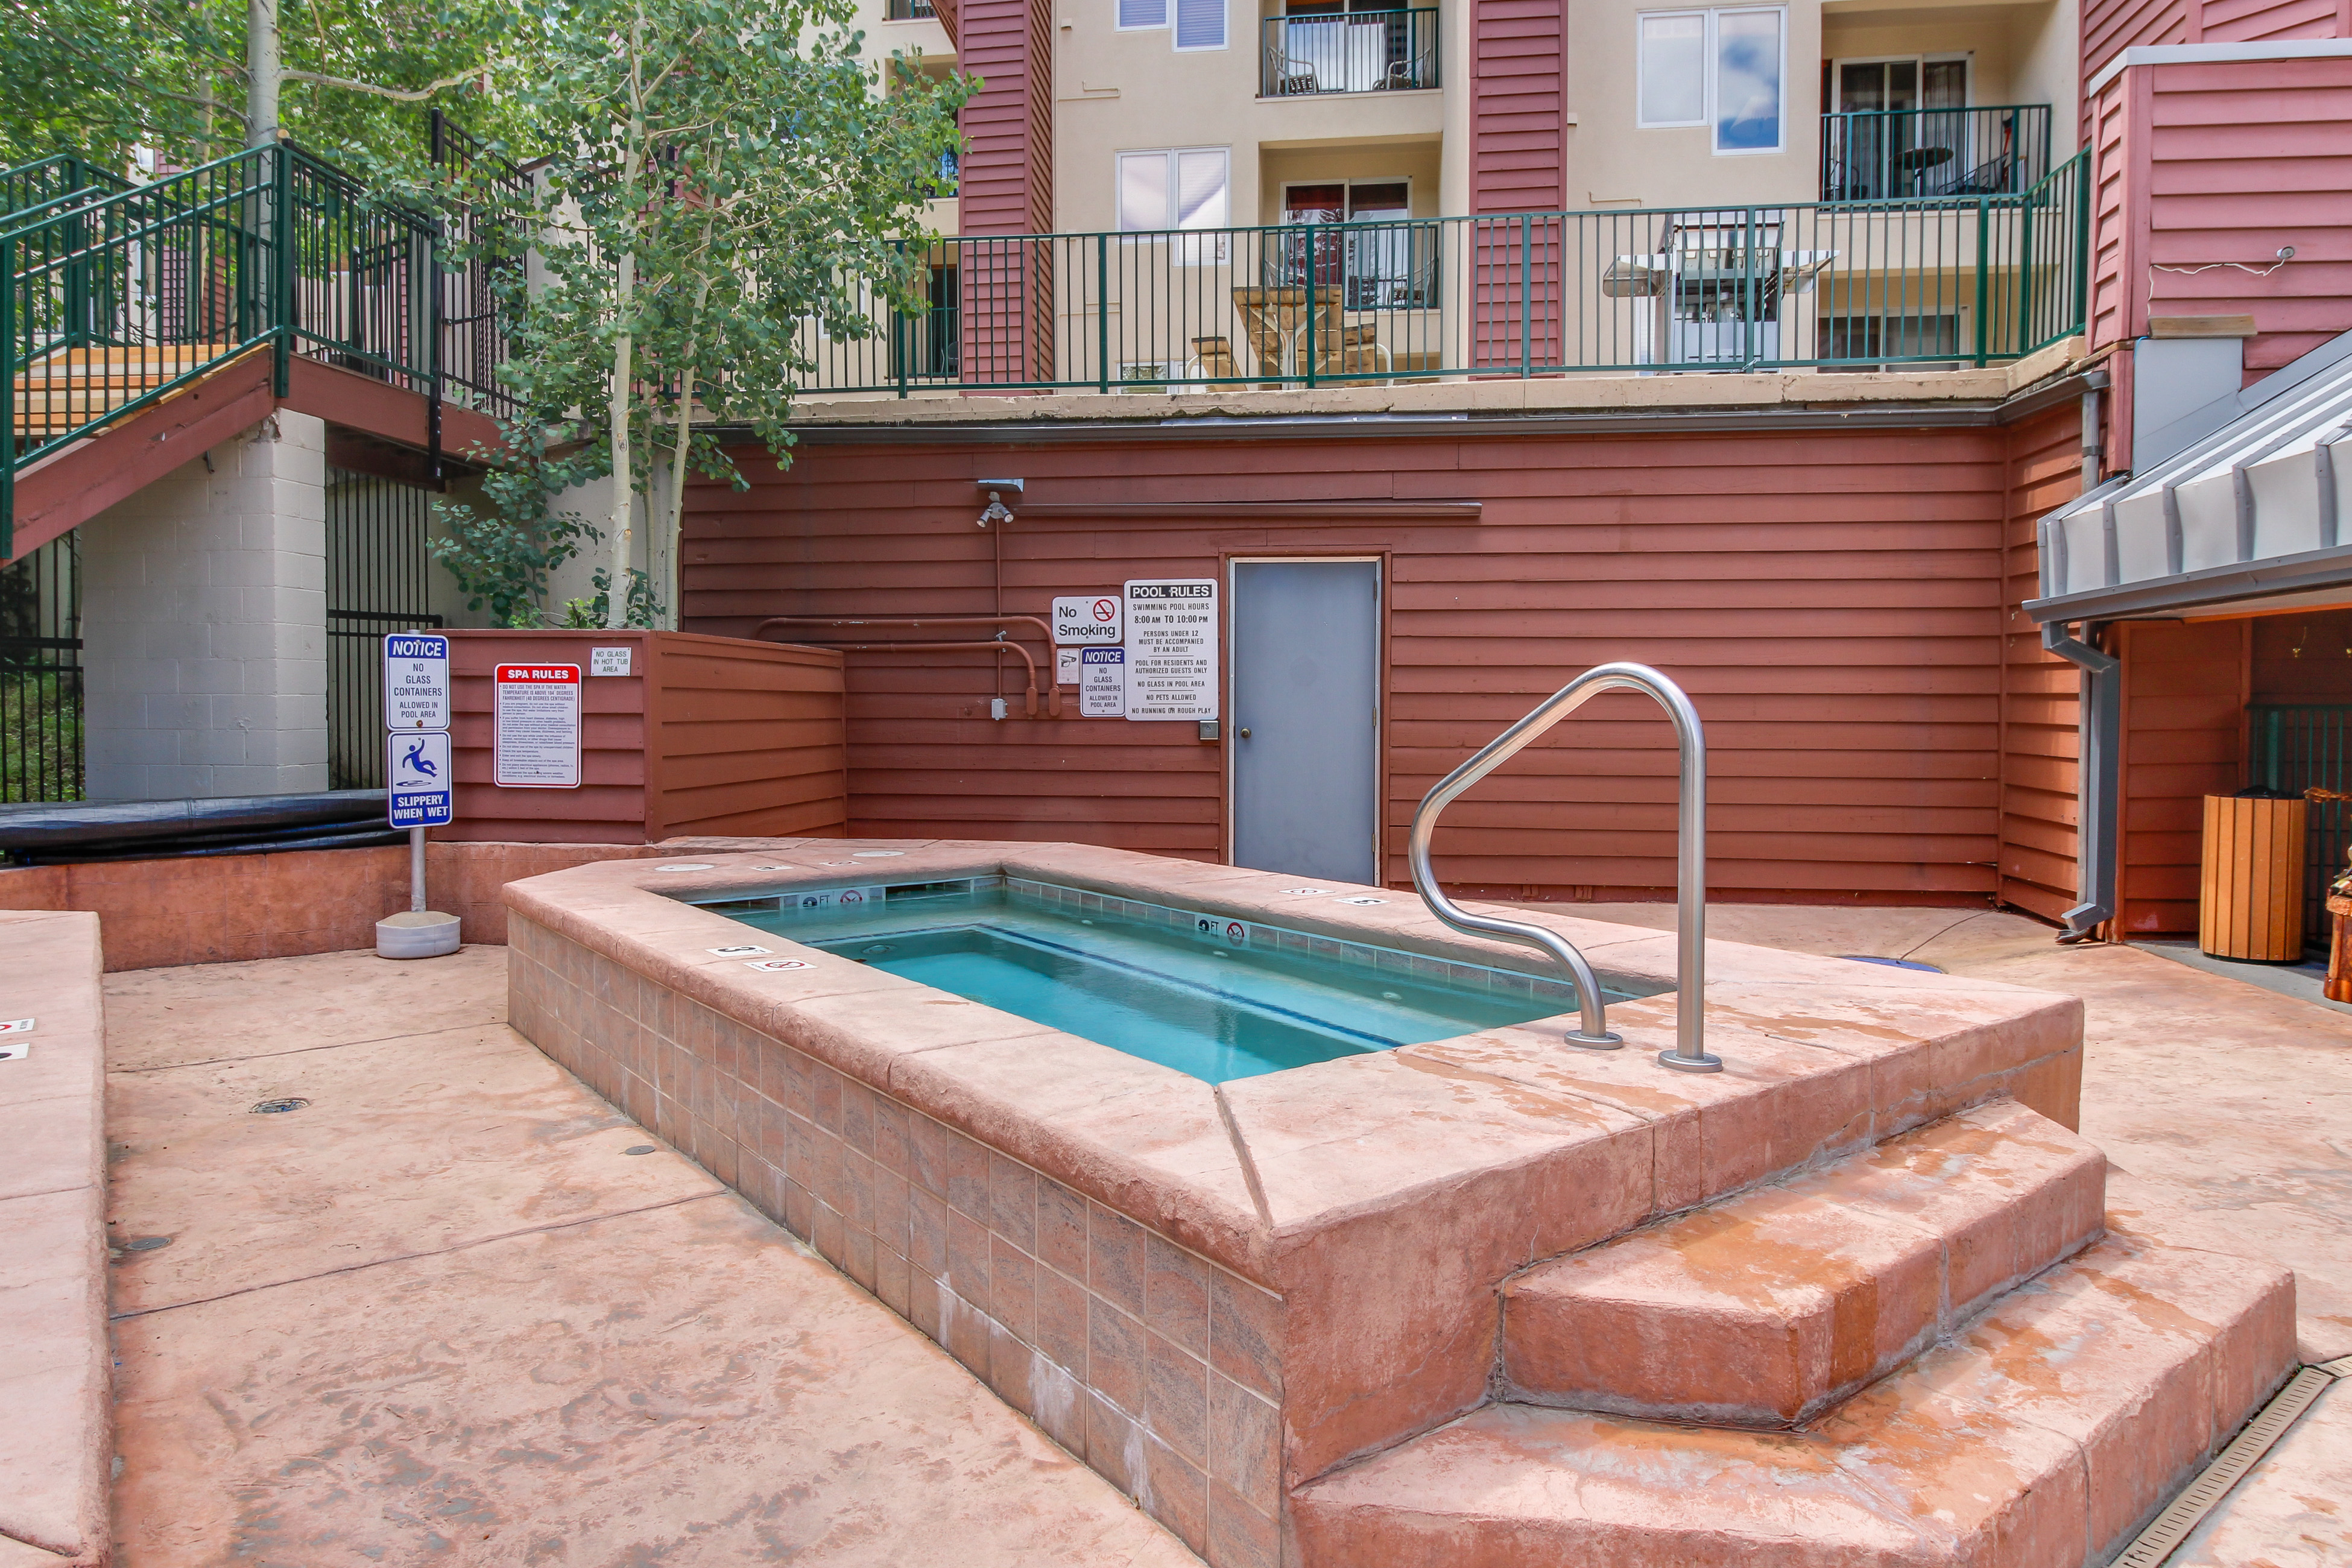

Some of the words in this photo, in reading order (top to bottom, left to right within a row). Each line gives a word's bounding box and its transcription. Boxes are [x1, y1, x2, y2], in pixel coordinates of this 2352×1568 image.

[1133, 587, 1166, 597] POOL
[1170, 586, 1209, 597] RULES
[1059, 606, 1076, 618] No
[1134, 615, 1150, 624] 8:00
[1059, 624, 1115, 639] Smoking
[393, 641, 442, 656] NOTICE
[1085, 651, 1121, 662] NOTICE
[413, 663, 423, 672] NO
[406, 675, 431, 684] GLASS
[508, 669, 530, 678] SPA
[532, 670, 569, 679] RULES
[394, 688, 442, 696] CONTAINERS
[398, 795, 443, 807] SLIPPERY
[394, 808, 423, 820] WHEN
[427, 806, 448, 817] WET
